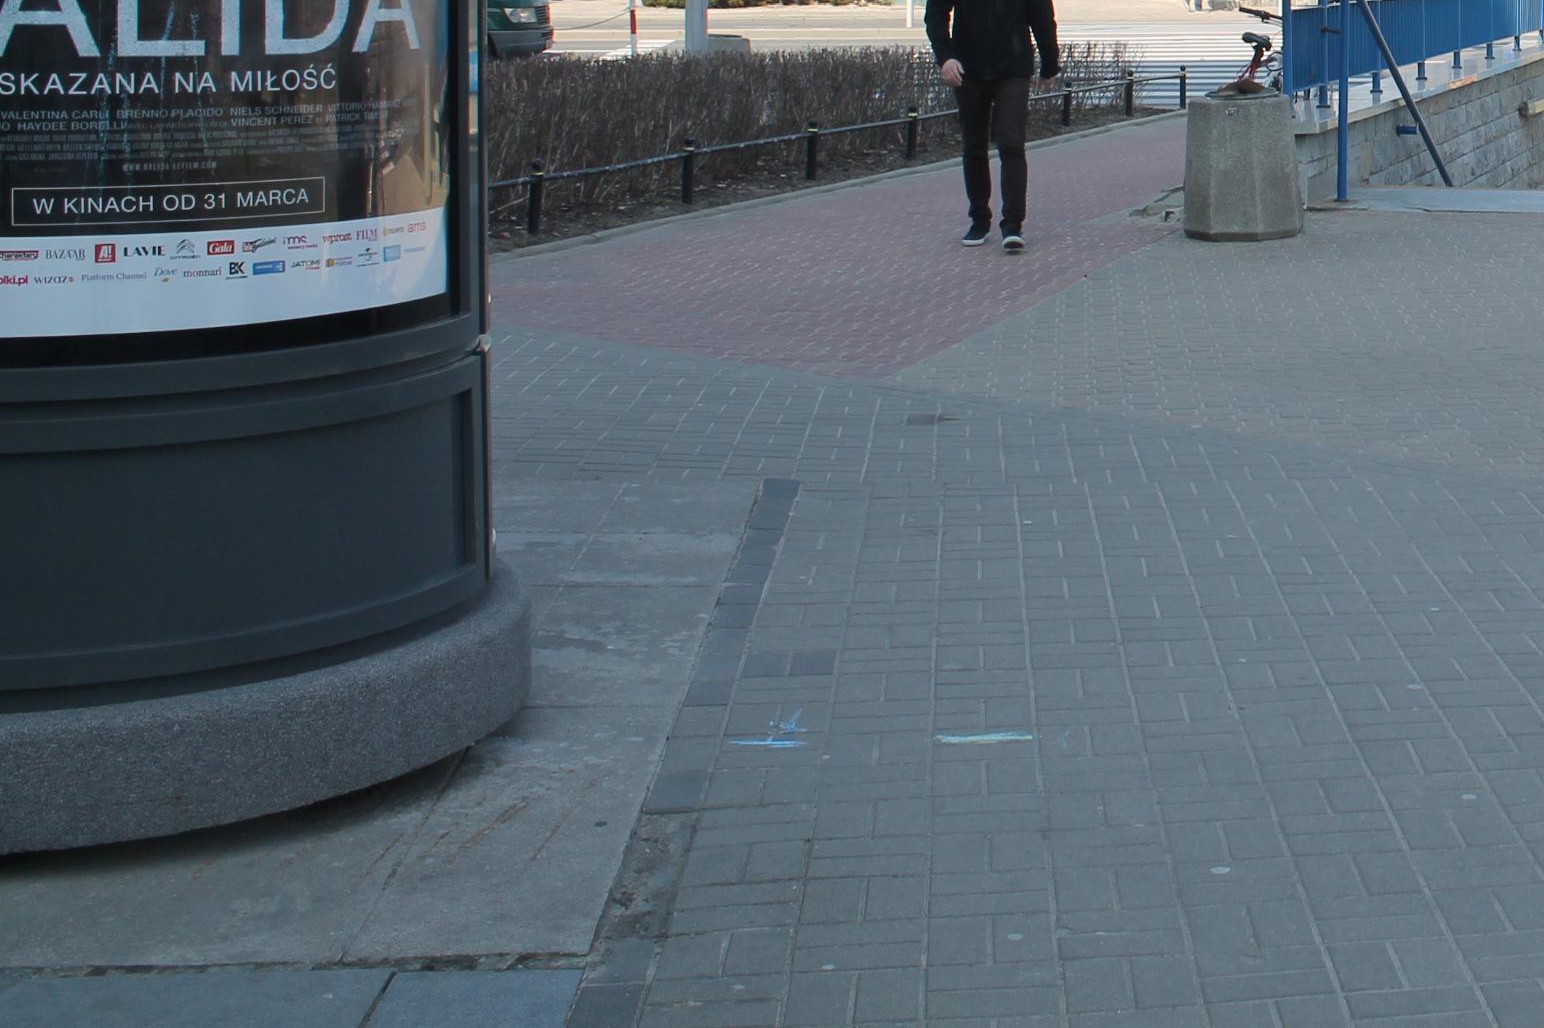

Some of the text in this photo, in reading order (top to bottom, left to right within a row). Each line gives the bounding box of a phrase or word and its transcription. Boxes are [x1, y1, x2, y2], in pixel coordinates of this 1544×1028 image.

[0, 64, 336, 95] SKAZANA NA MIŁOŚĆ
[1, 110, 68, 120] VALENTINA
[117, 108, 168, 119] BRENNO
[230, 106, 262, 117] NIELS
[264, 103, 323, 115] SCHNEIDER
[17, 121, 67, 131] HAYDEE
[231, 115, 277, 127] VINCENT
[281, 114, 313, 125] PEREZ
[32, 188, 309, 214] W KINACH OD 31 MARCA
[209, 242, 233, 254] Gala
